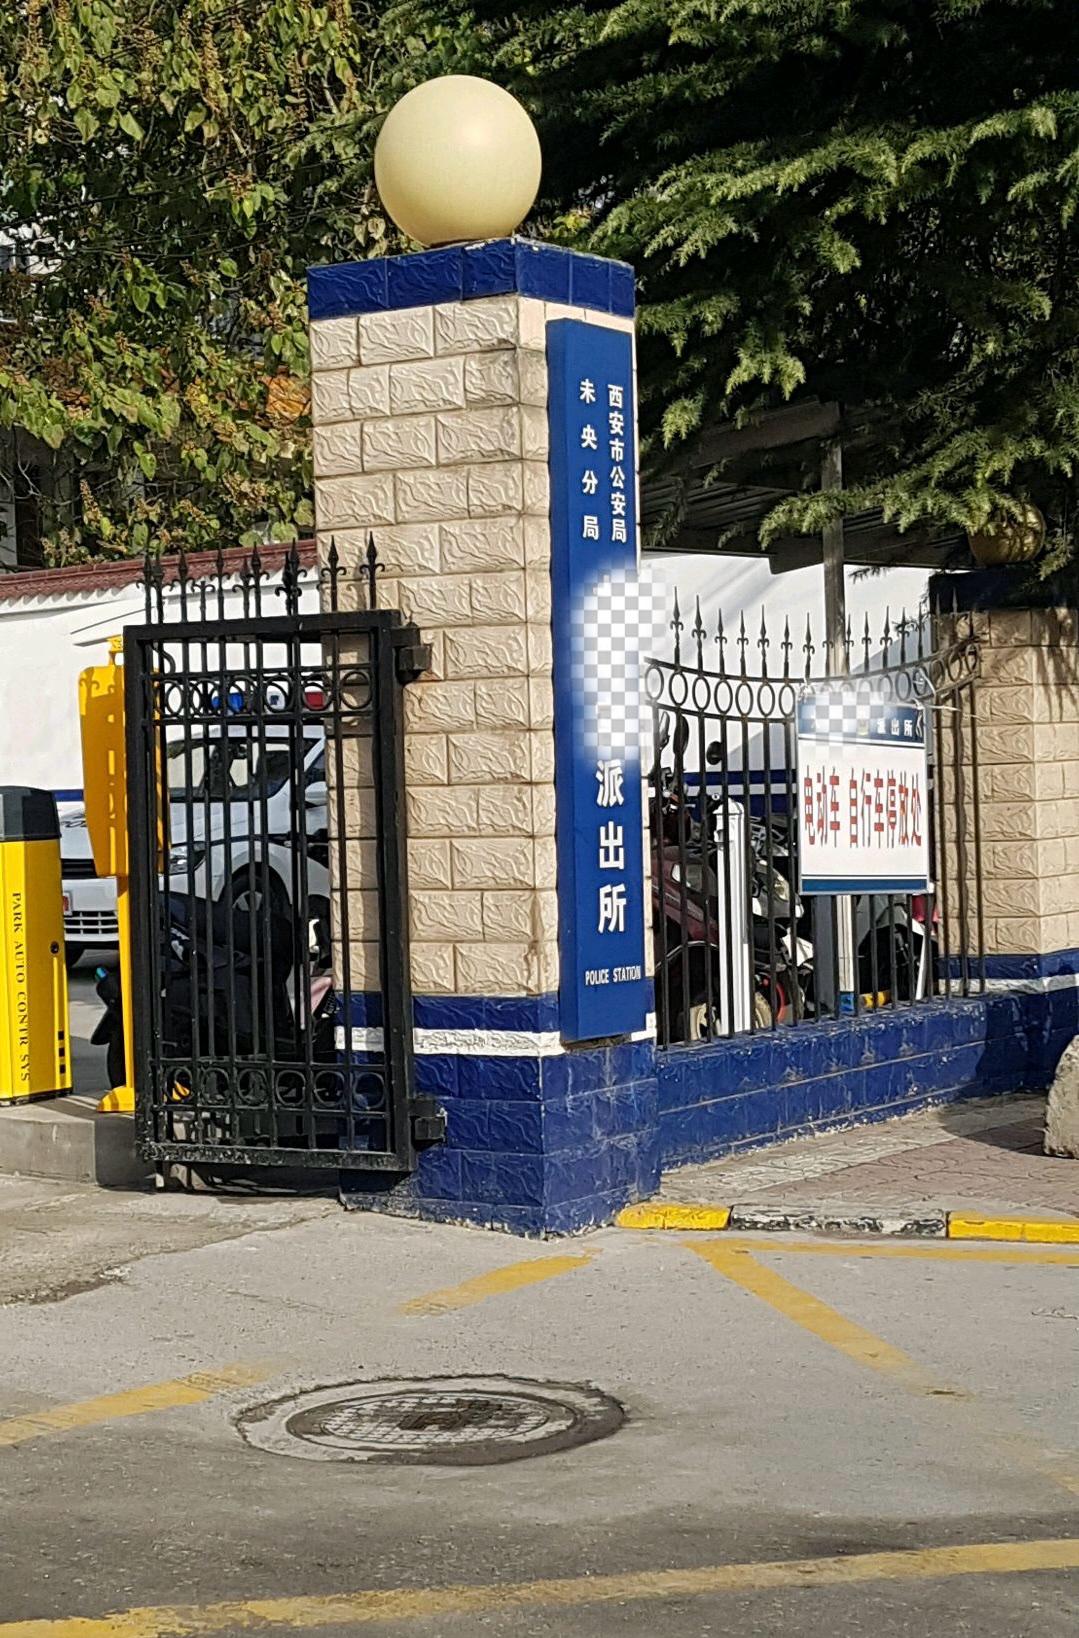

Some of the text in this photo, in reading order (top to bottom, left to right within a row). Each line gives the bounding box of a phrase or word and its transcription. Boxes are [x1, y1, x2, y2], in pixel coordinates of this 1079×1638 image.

[579, 378, 600, 541] 未央分局
[607, 384, 628, 543] 西安市公安局
[595, 758, 627, 935] 派出所
[12, 892, 23, 932] PARK
[15, 941, 26, 984] AUTO
[585, 965, 641, 986] POLICE STATION
[20, 1054, 31, 1081] SYS
